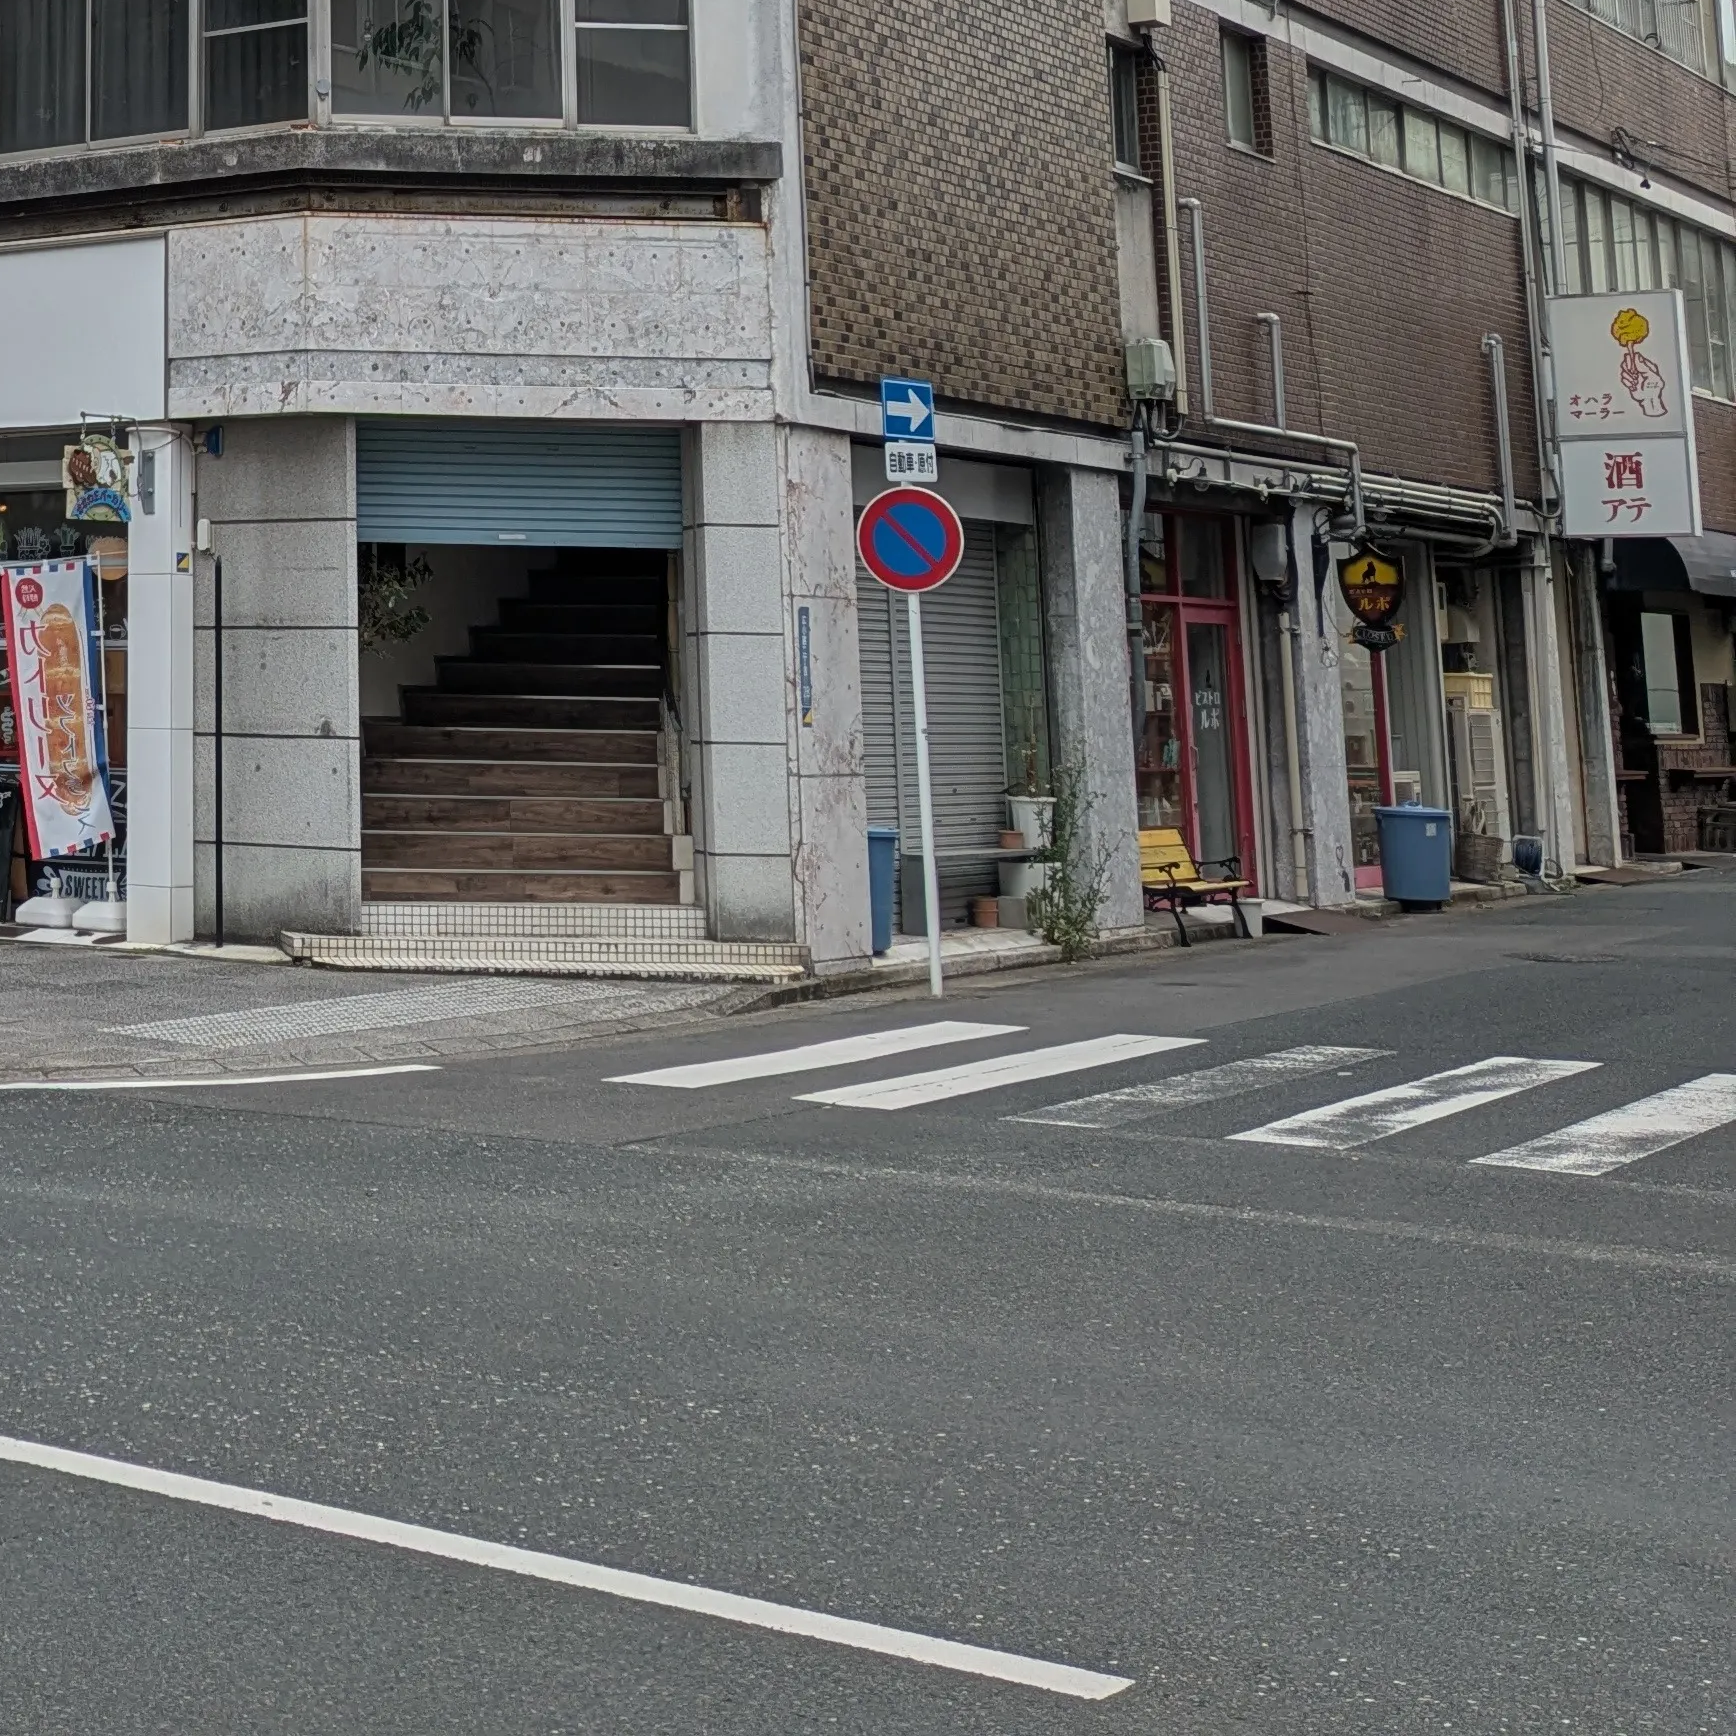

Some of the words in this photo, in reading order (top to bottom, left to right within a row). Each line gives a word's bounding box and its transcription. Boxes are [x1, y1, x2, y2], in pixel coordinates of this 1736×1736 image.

[1569, 393, 1613, 407] オハラ
[1569, 407, 1625, 419] マーラー
[1603, 451, 1644, 489] 酒
[1601, 496, 1653, 522] アテ
[1194, 690, 1221, 706] ビストロ
[65, 874, 112, 900] SWEET
